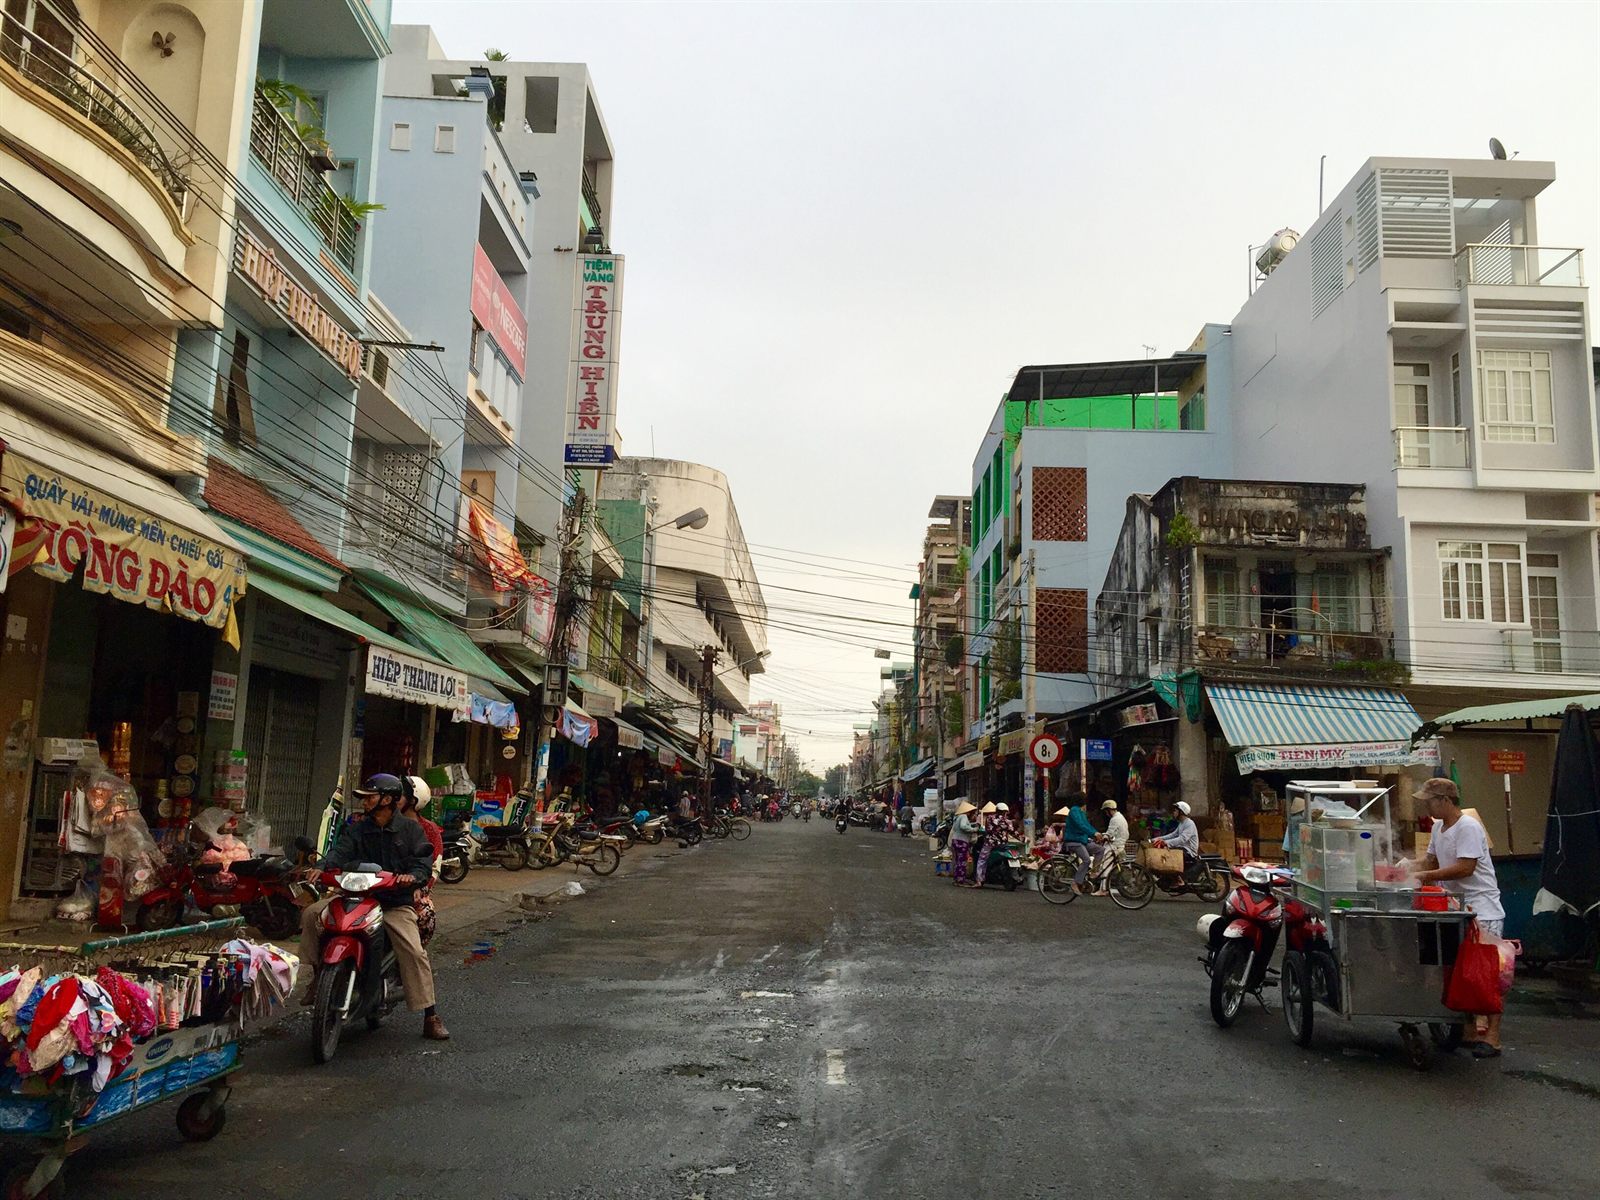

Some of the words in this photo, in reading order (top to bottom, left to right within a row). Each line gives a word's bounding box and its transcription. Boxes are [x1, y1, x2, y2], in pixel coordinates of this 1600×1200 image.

[583, 270, 614, 283] VÀNG
[584, 258, 613, 271] TIỆM
[582, 285, 608, 359] TRUNG
[25, 474, 67, 506] QUẦY
[71, 491, 94, 517] VẢI
[99, 504, 136, 533] MÙNG
[140, 519, 167, 547] MỀN
[170, 534, 202, 561] CHIẾU
[147, 558, 216, 616] ĐÀO
[372, 654, 400, 688] HIỆP
[403, 663, 439, 692] THÀNH
[440, 674, 456, 700] LỢI
[512, 799, 527, 825] TEA
